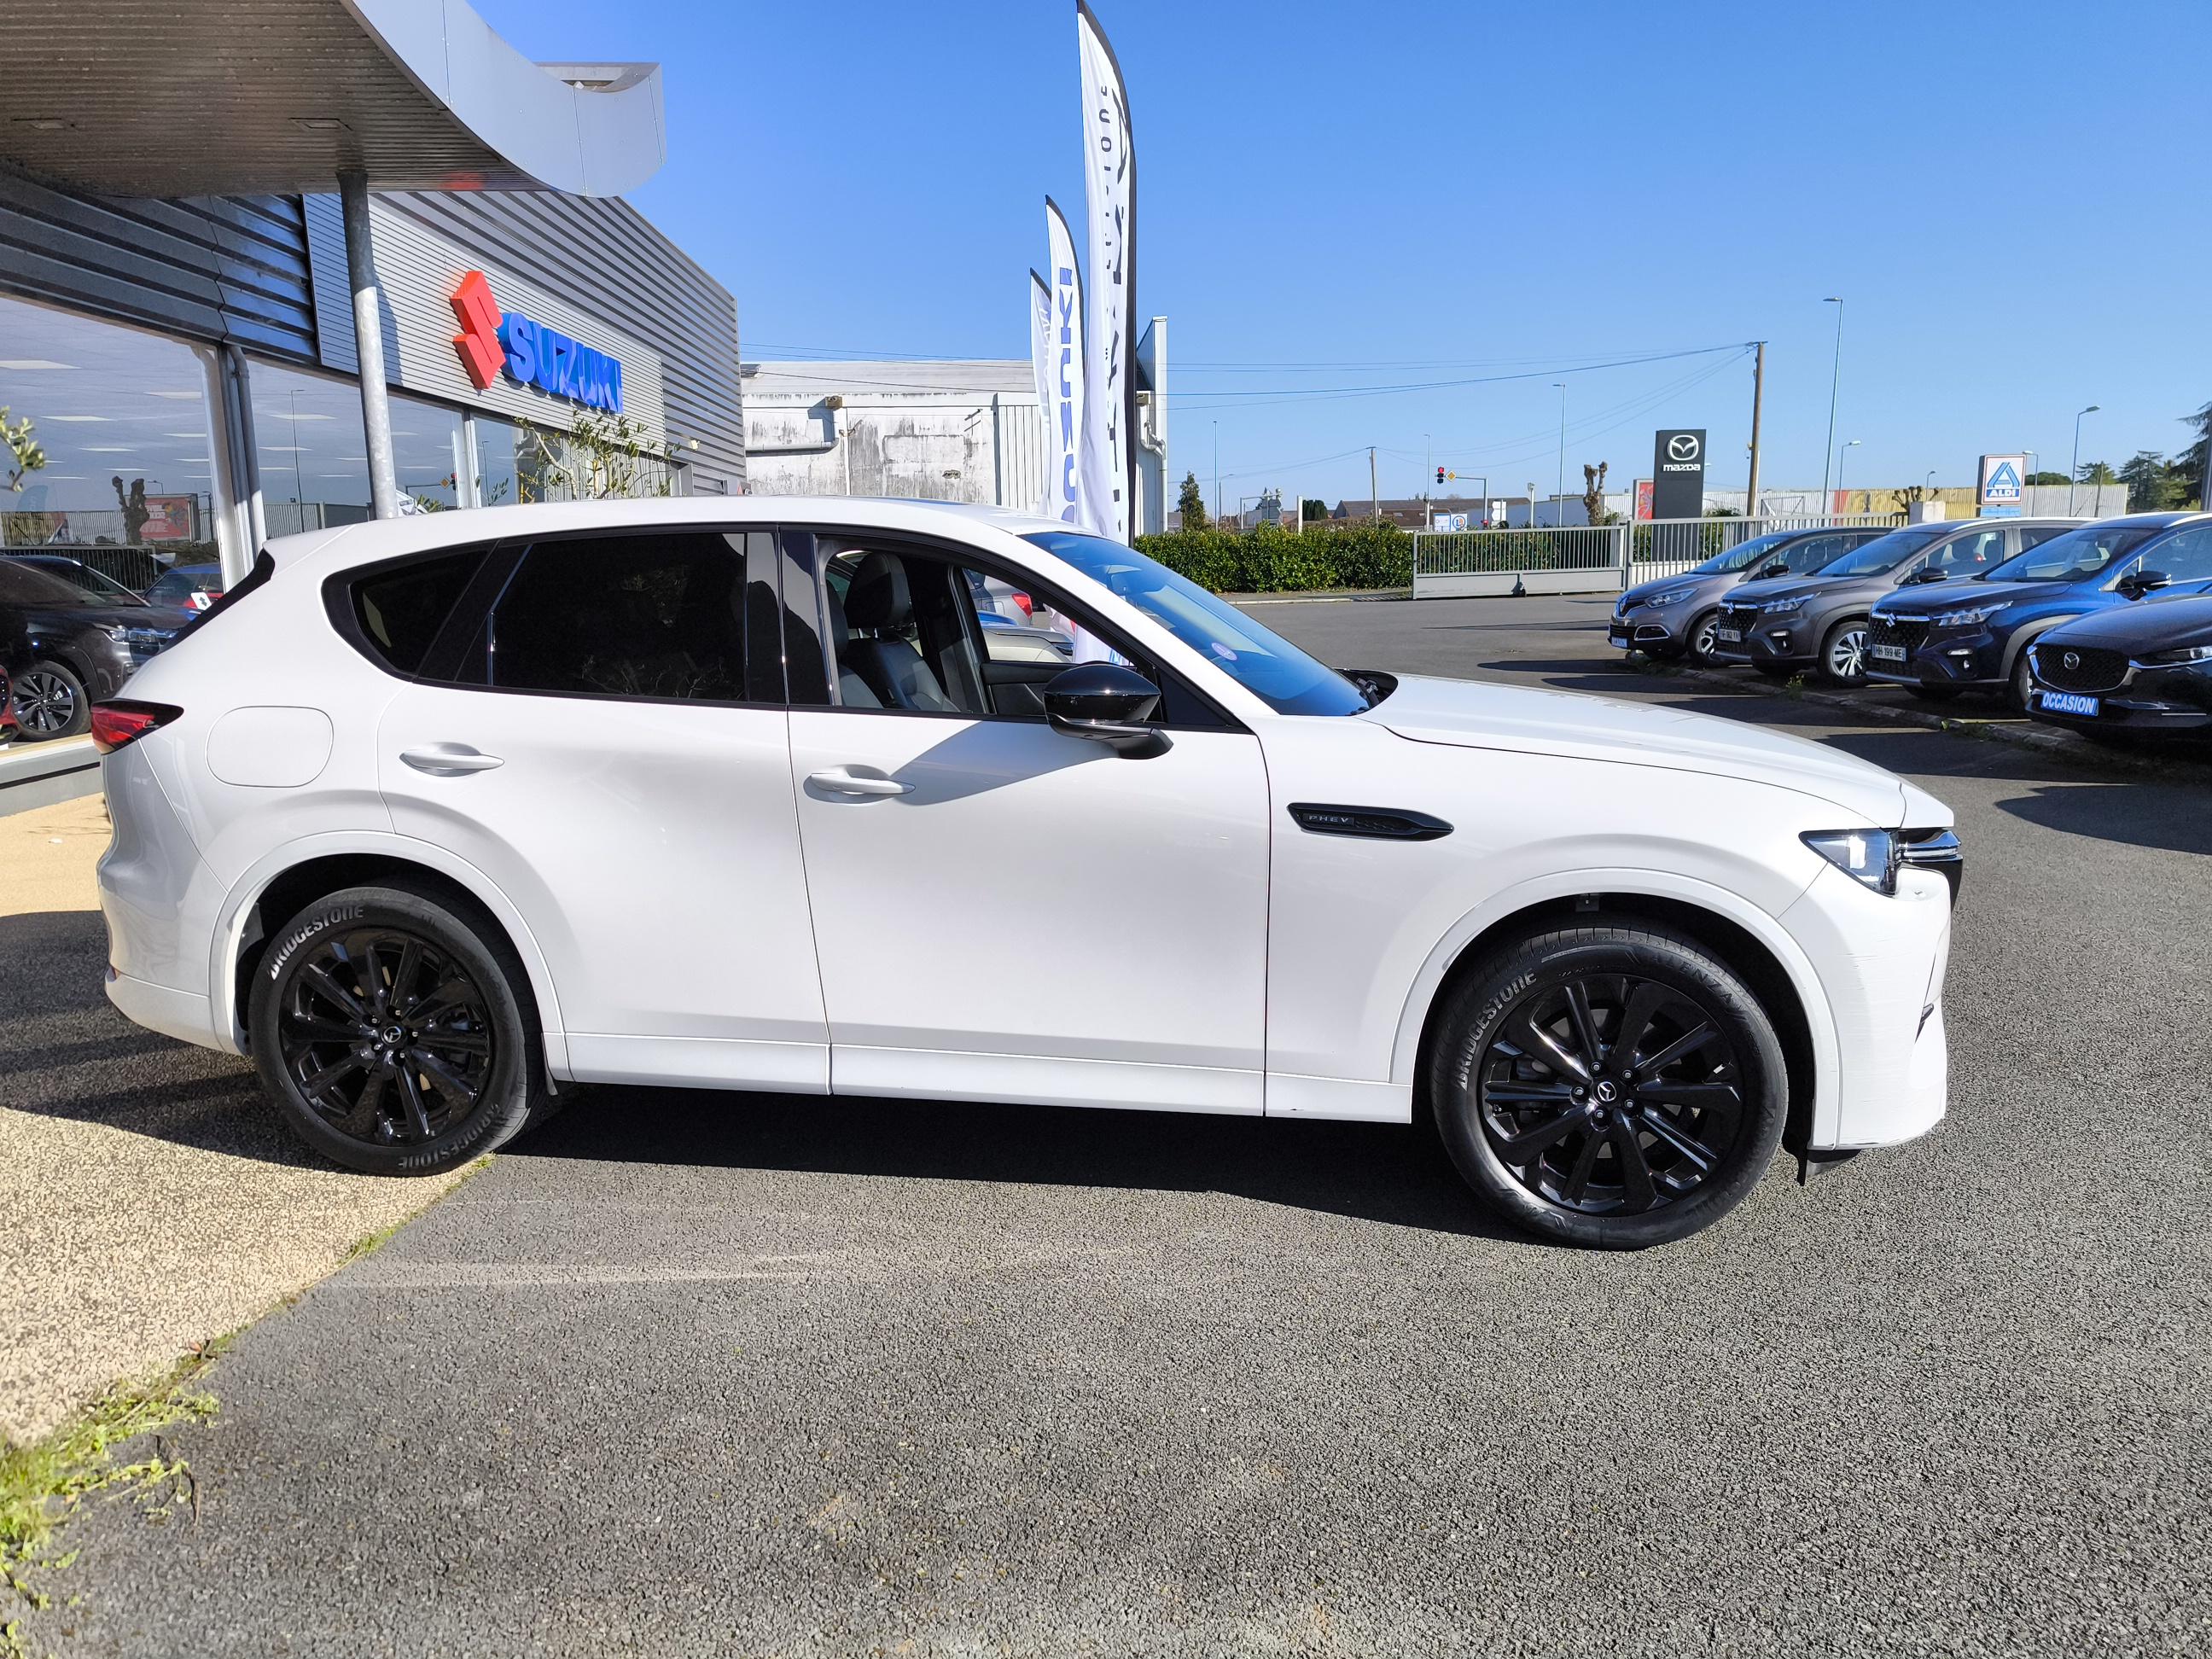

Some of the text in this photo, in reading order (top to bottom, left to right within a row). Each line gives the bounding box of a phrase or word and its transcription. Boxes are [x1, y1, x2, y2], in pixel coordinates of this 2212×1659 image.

[500, 312, 625, 414] SUZUKI
[1988, 489, 2017, 498] ALDI
[2042, 692, 2096, 713] OCCASION
[1308, 814, 1349, 824] PHEV
[268, 905, 364, 981] BRIDGESTONE
[1455, 968, 1537, 1092] BRIDGESTONE
